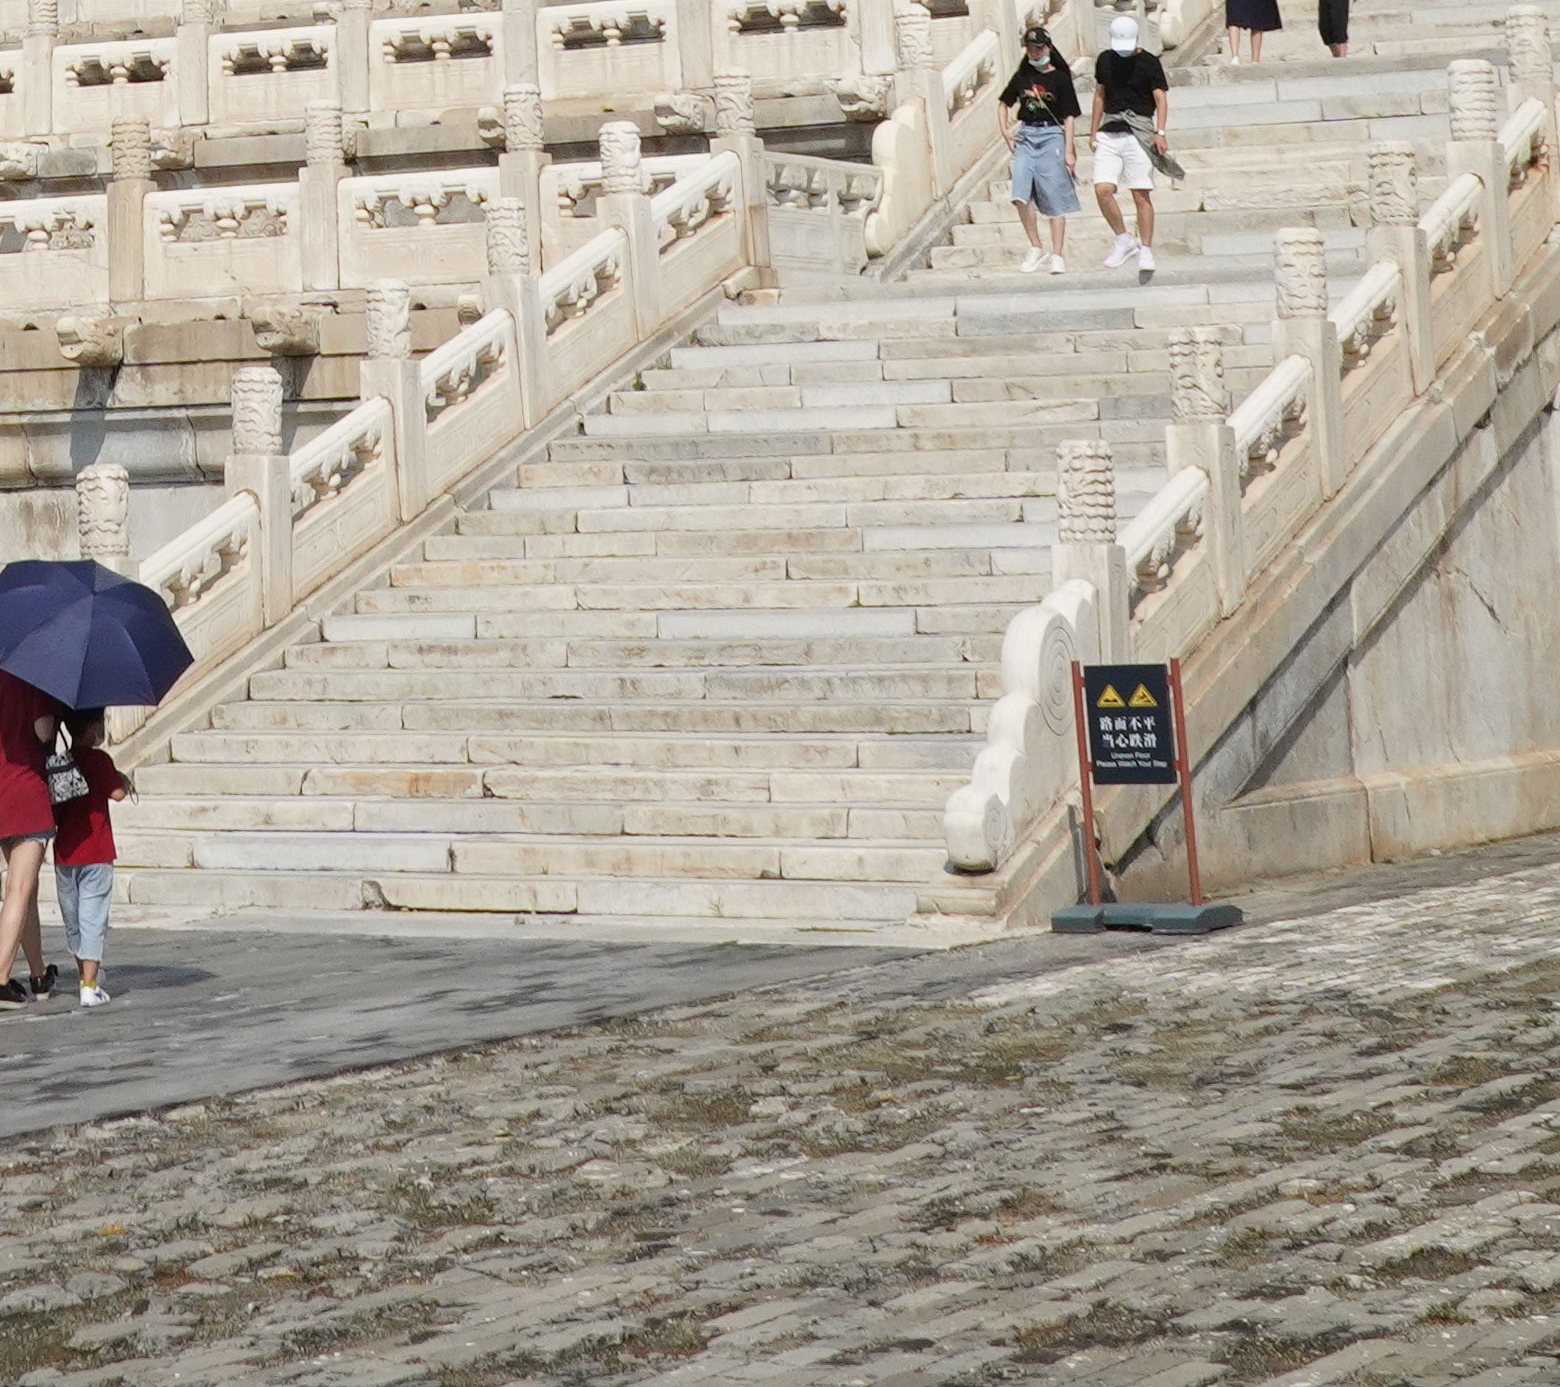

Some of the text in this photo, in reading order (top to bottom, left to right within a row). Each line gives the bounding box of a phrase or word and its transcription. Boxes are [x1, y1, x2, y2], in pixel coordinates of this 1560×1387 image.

[1099, 716, 1156, 731] 路面不平
[1101, 733, 1157, 748] 当心跌滑
